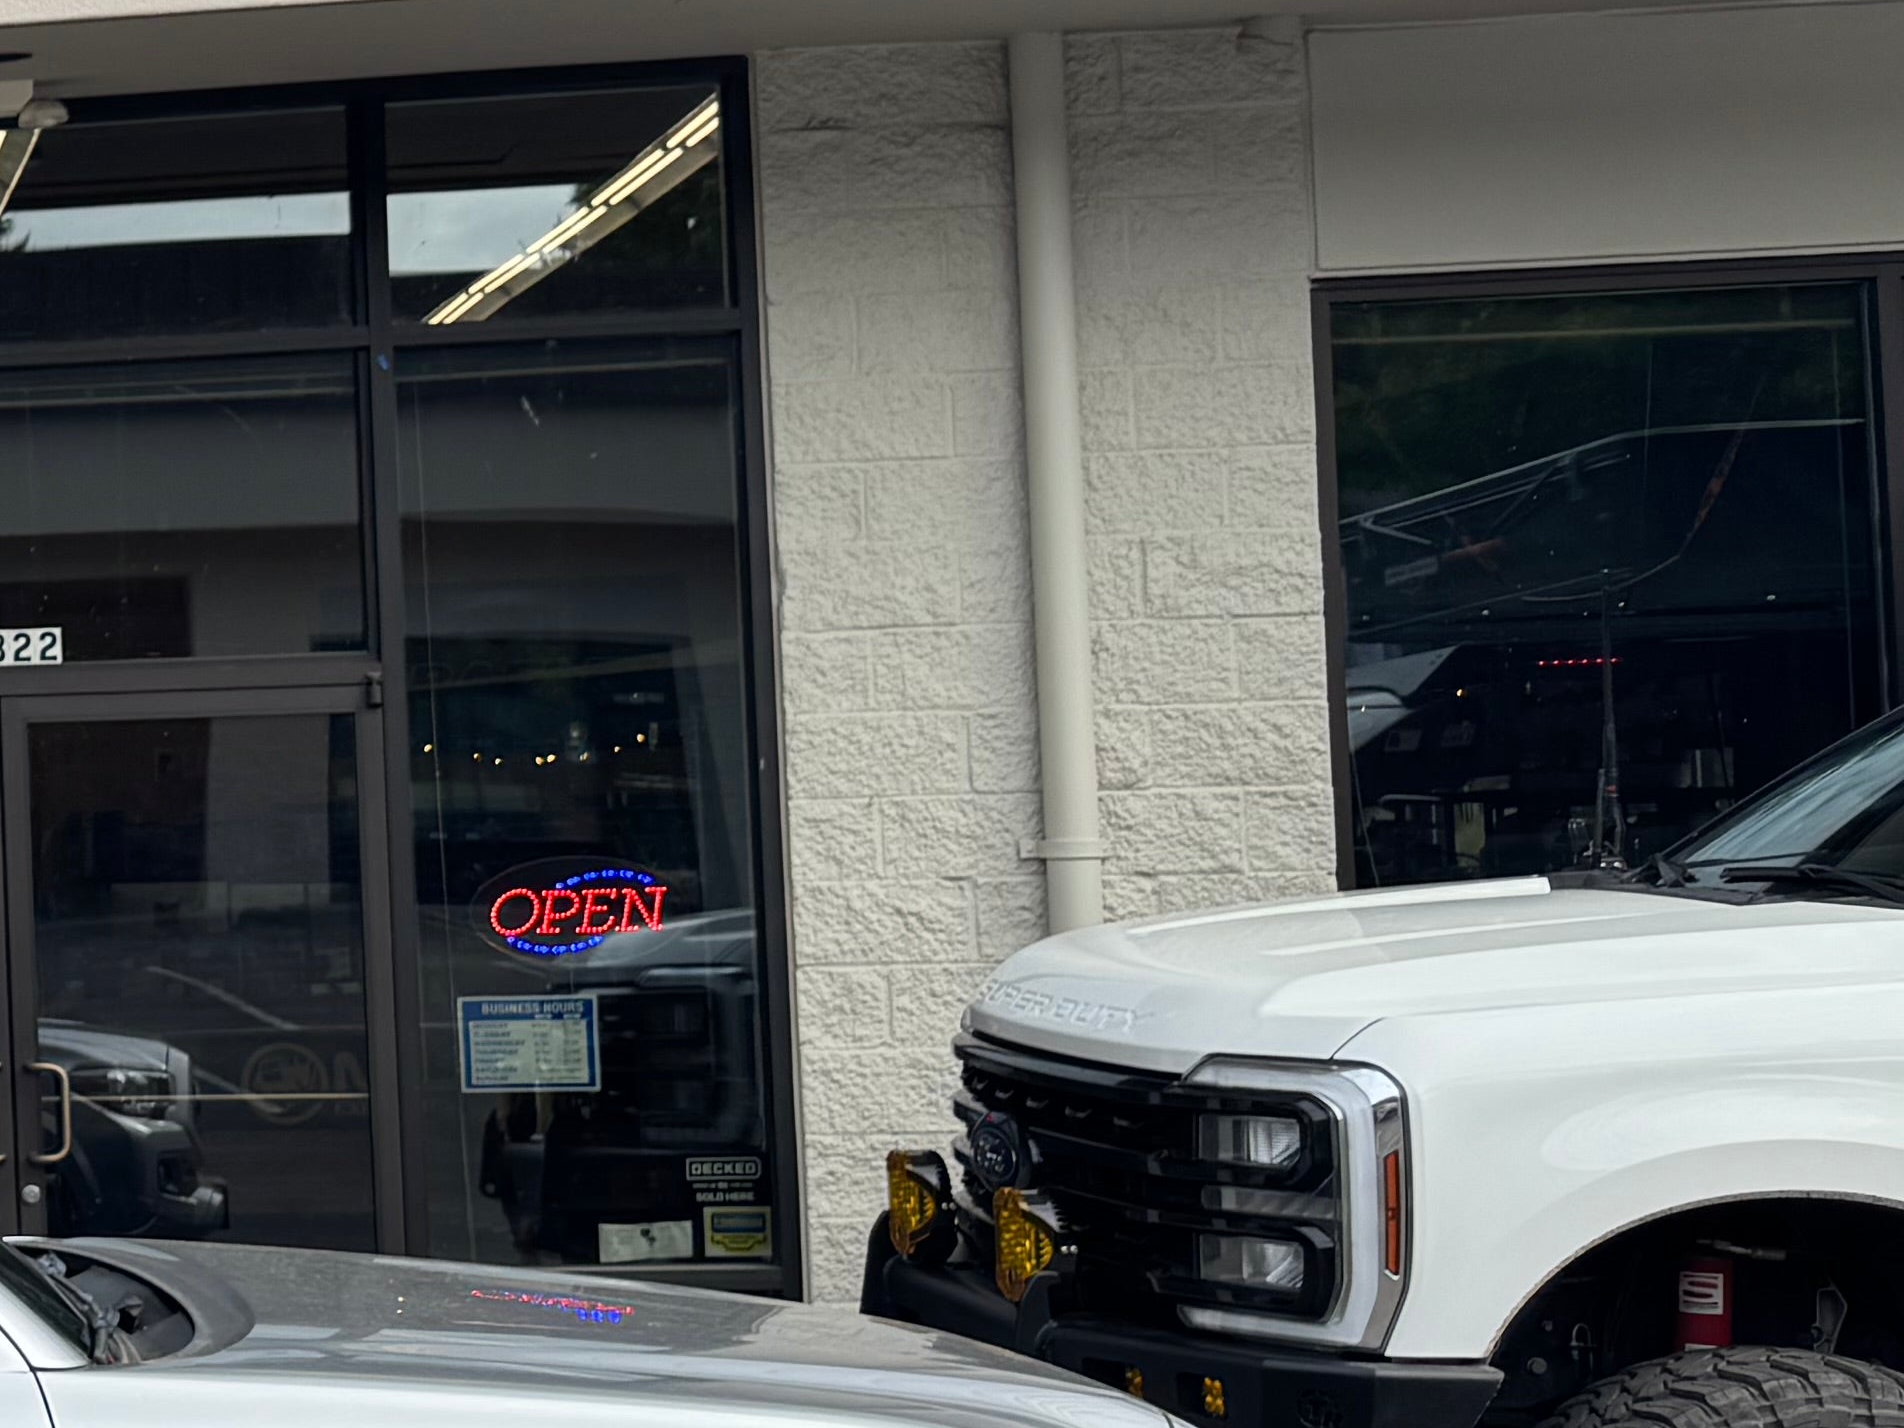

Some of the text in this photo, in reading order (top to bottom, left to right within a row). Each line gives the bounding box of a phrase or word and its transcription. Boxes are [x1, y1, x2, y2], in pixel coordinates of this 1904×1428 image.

[490, 885, 668, 938] OPEN
[481, 1001, 584, 1015] BUSINESS HOURS
[1053, 996, 1156, 1036] DUTY
[690, 1161, 757, 1175] DECKED
